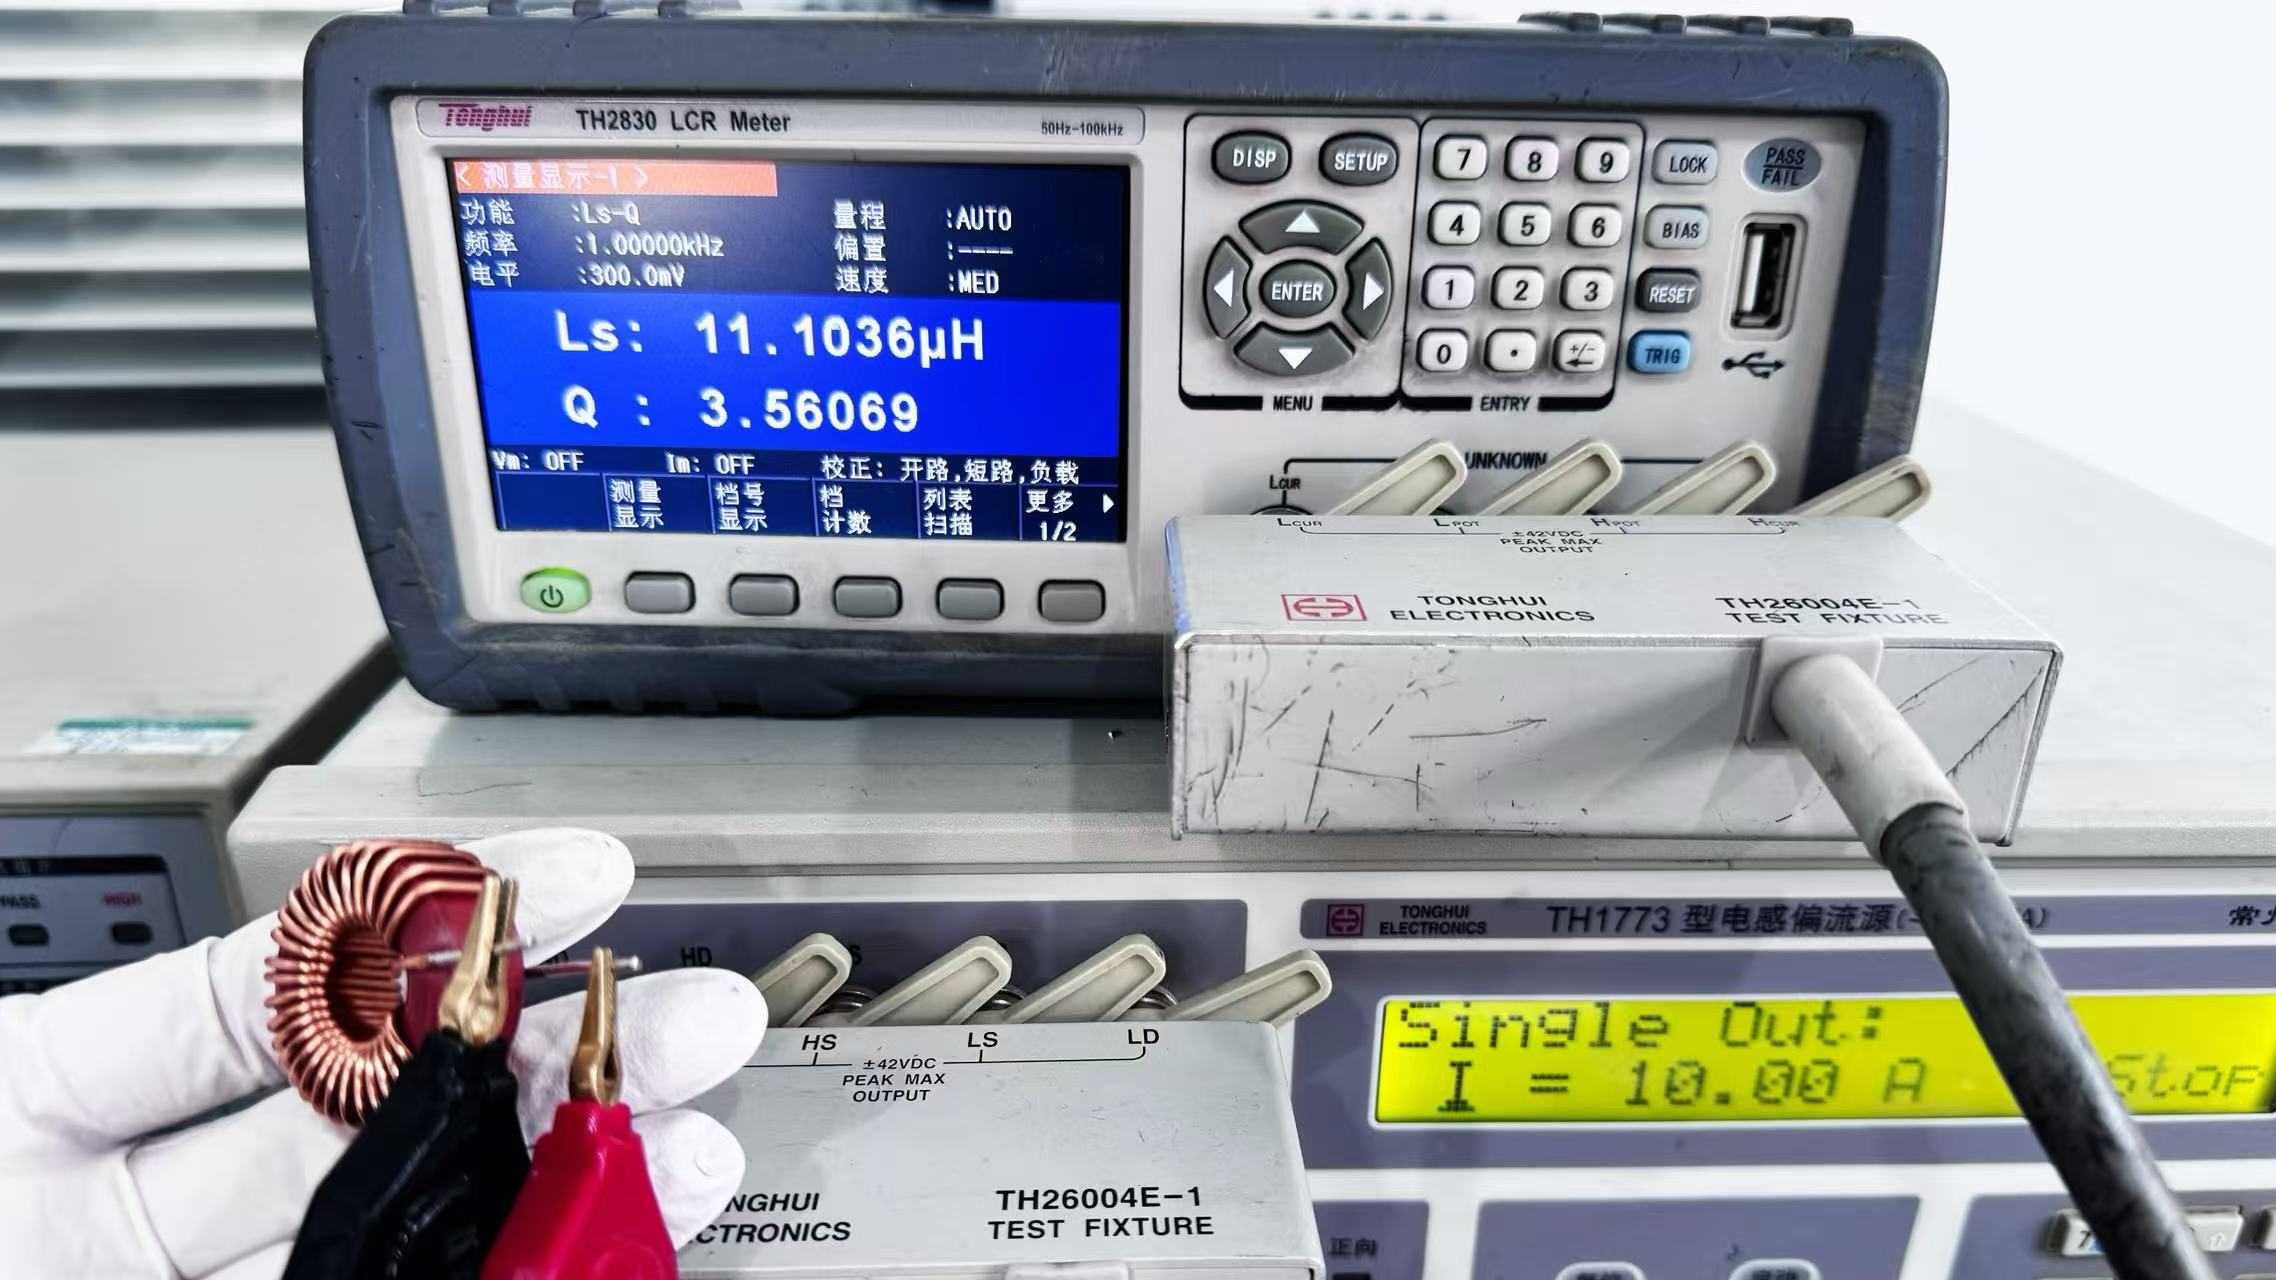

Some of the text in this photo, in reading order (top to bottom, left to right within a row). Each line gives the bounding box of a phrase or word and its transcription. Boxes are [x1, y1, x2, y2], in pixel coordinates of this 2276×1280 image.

[576, 109, 791, 133] TH2830 LCR Meter
[1040, 121, 1124, 137] 50Hz-100kHz
[1232, 150, 1277, 168] DISP
[1334, 153, 1388, 172] SETUP
[1457, 148, 1472, 171] 7
[1527, 152, 1542, 173] 8
[1599, 153, 1614, 174] 9
[1669, 156, 1709, 174] LOCK
[1765, 147, 1805, 166] PASS
[1761, 169, 1800, 187] FAIL
[461, 200, 515, 226] 功能
[834, 200, 887, 230] 量程
[1449, 215, 1464, 237] 4
[1520, 215, 1535, 237] 5
[1592, 217, 1606, 238] 6
[1662, 222, 1700, 240] BIAS
[463, 231, 518, 257] 频率
[835, 234, 887, 262] 偏置
[471, 262, 520, 288] 电平
[836, 266, 889, 294] 速度
[1271, 281, 1324, 302] ENTER
[1444, 279, 1455, 300] 1
[1513, 280, 1529, 302] 2
[1584, 282, 1599, 302] 3
[1649, 285, 1696, 305] RESET
[554, 310, 644, 353] Ls:
[1437, 343, 1452, 365] 0
[1644, 347, 1682, 366] TRIG
[562, 385, 597, 429] Q
[700, 388, 918, 434] 3.56069
[1272, 397, 1313, 411] MENU
[1480, 397, 1530, 411] ENTRY
[544, 451, 584, 472] OFF
[714, 454, 756, 475] OFF
[1465, 452, 1548, 471] UNKNOWN
[610, 479, 662, 504] 测量
[715, 482, 765, 506] 档号
[820, 485, 844, 509] 档
[922, 488, 973, 512] 列表
[1025, 489, 1075, 514] 更多
[615, 505, 664, 529] 显示
[719, 508, 767, 531] 显示
[822, 510, 872, 535] 计数
[922, 512, 973, 537] 扫描
[1040, 521, 1077, 542] 1/2
[1500, 538, 1602, 546] PEAK MAX
[1520, 546, 1594, 554] OUTPUT
[1417, 596, 1548, 606] TONGHUI
[1715, 597, 1921, 610] TH26004E-1
[1390, 610, 1596, 622] ELECTRONICS
[1725, 613, 1949, 625] TEST FIXTURE
[1400, 905, 1469, 919] TONGHUI
[1548, 905, 1670, 933] TH1773
[1379, 921, 1487, 935] ELECTRONICS
[681, 947, 712, 967] HD
[1398, 1000, 1881, 1047] Single Out:
[802, 1034, 837, 1051] HS
[967, 1032, 998, 1048] LS
[1128, 1029, 1159, 1045] LD
[842, 1073, 946, 1086] PEAK MAX
[1529, 1073, 1570, 1093] =
[1625, 1059, 1839, 1105] 10.00
[1884, 1057, 1926, 1103] A
[853, 1090, 931, 1102] OUTPUT
[726, 1193, 820, 1212] NGHUI
[996, 1187, 1201, 1210] TH26004E-1
[692, 1222, 852, 1243] CTRONICS
[988, 1216, 1214, 1240] TEST FIXTURE
